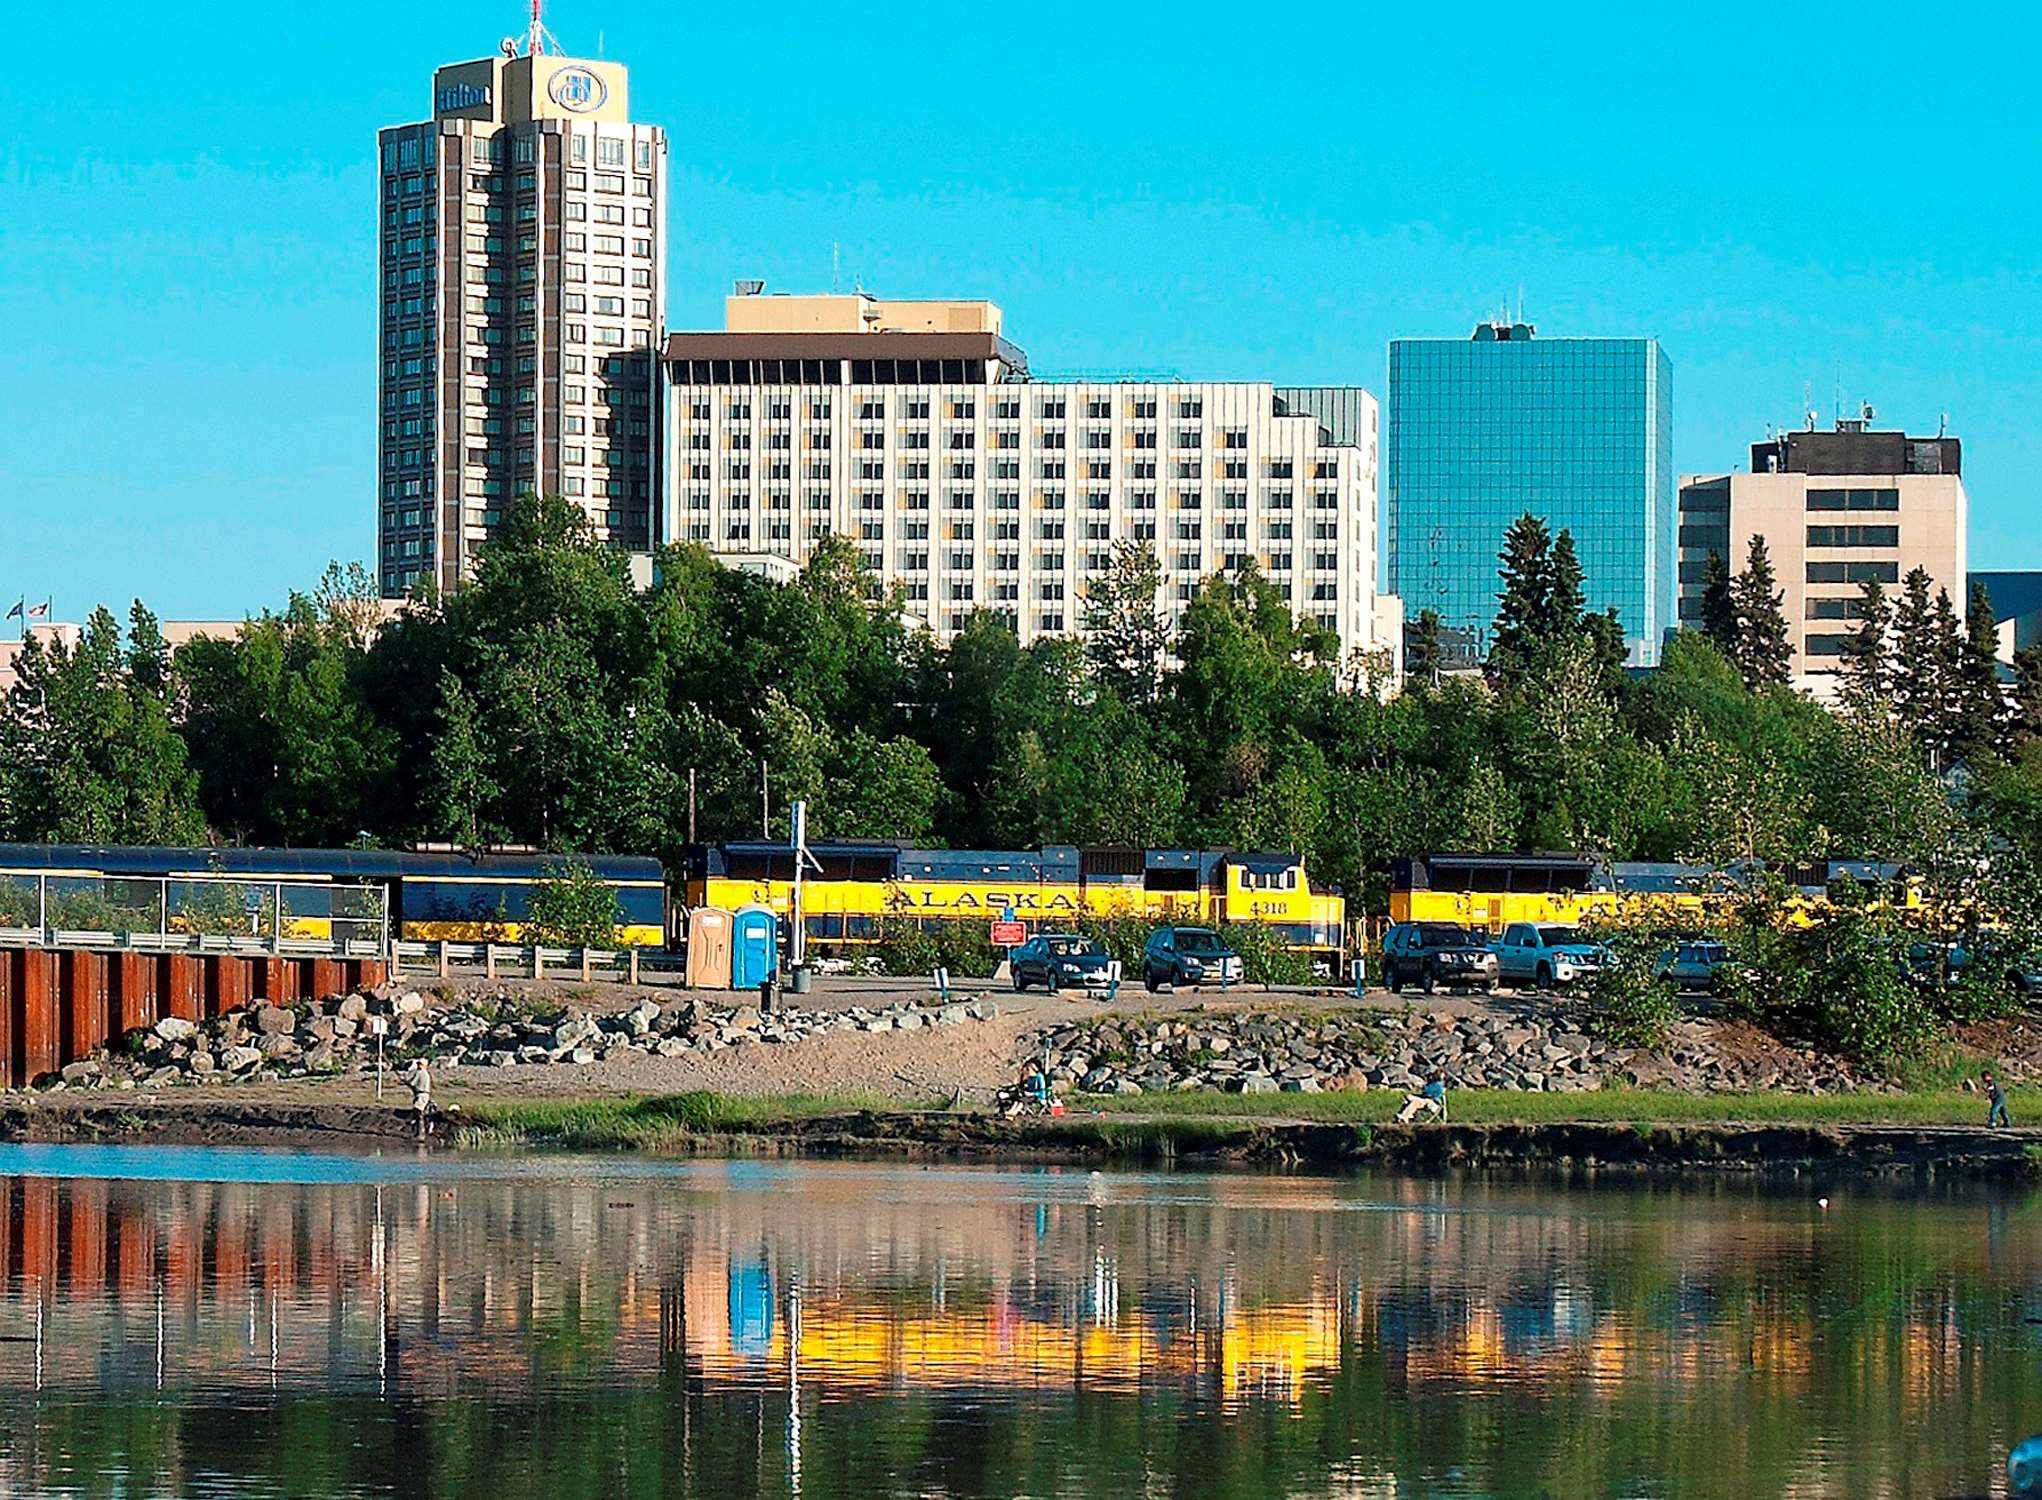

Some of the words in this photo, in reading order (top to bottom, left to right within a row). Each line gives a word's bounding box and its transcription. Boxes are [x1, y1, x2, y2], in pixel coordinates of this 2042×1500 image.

[438, 83, 491, 112] Hilton
[888, 891, 1075, 909] ALASKA
[1249, 901, 1288, 916] 4318
